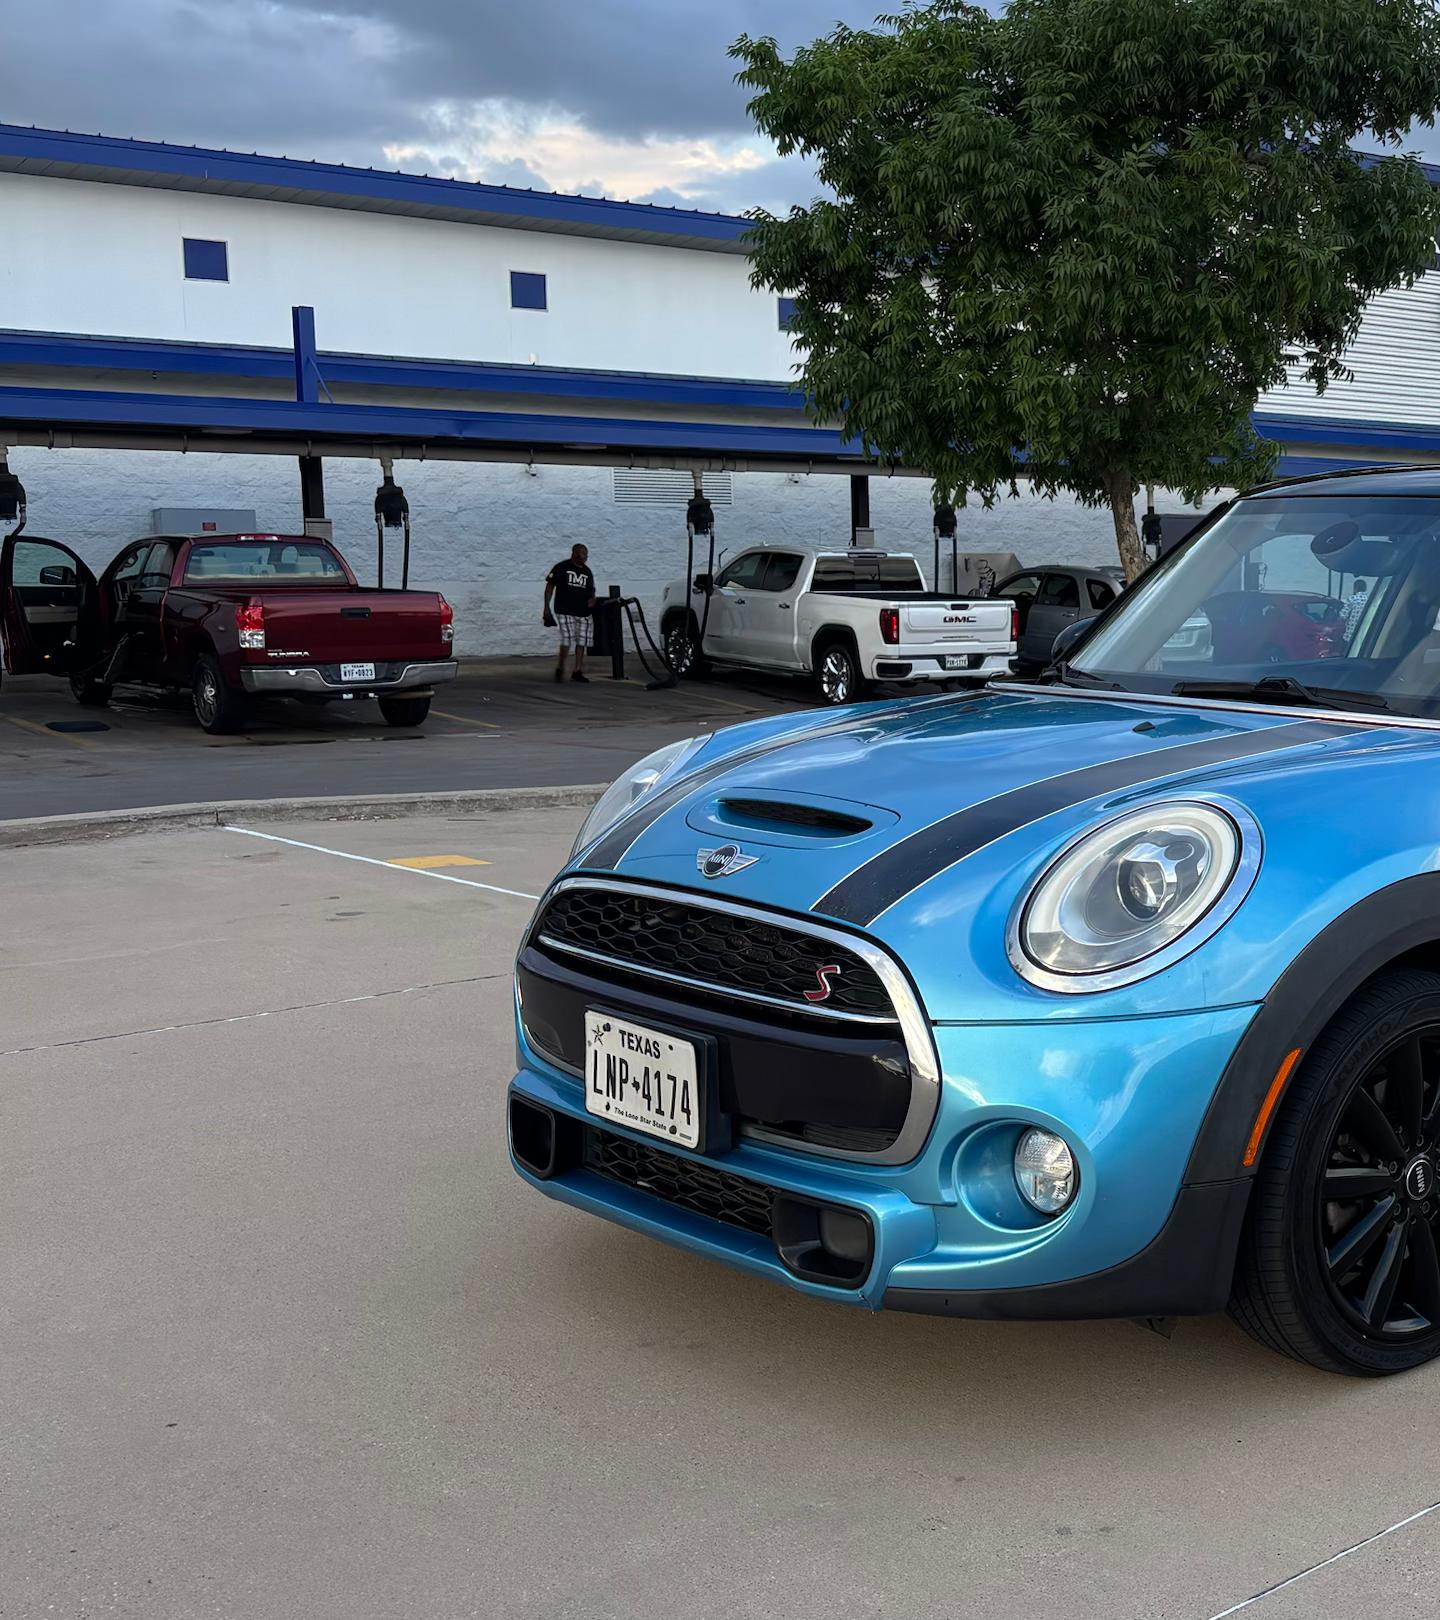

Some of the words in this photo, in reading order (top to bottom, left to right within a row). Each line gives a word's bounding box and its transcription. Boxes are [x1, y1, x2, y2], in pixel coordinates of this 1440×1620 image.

[566, 571, 588, 586] TMT
[709, 853, 734, 865] MINI
[803, 965, 841, 1001] S
[618, 1029, 661, 1059] TEXAS
[593, 1049, 629, 1102] LNP
[642, 1066, 692, 1126] 4174
[614, 1106, 624, 1117] The
[625, 1110, 639, 1121] Lone
[640, 1116, 652, 1125] Star
[652, 1119, 667, 1131] State
[1415, 1165, 1425, 1193] MINI
